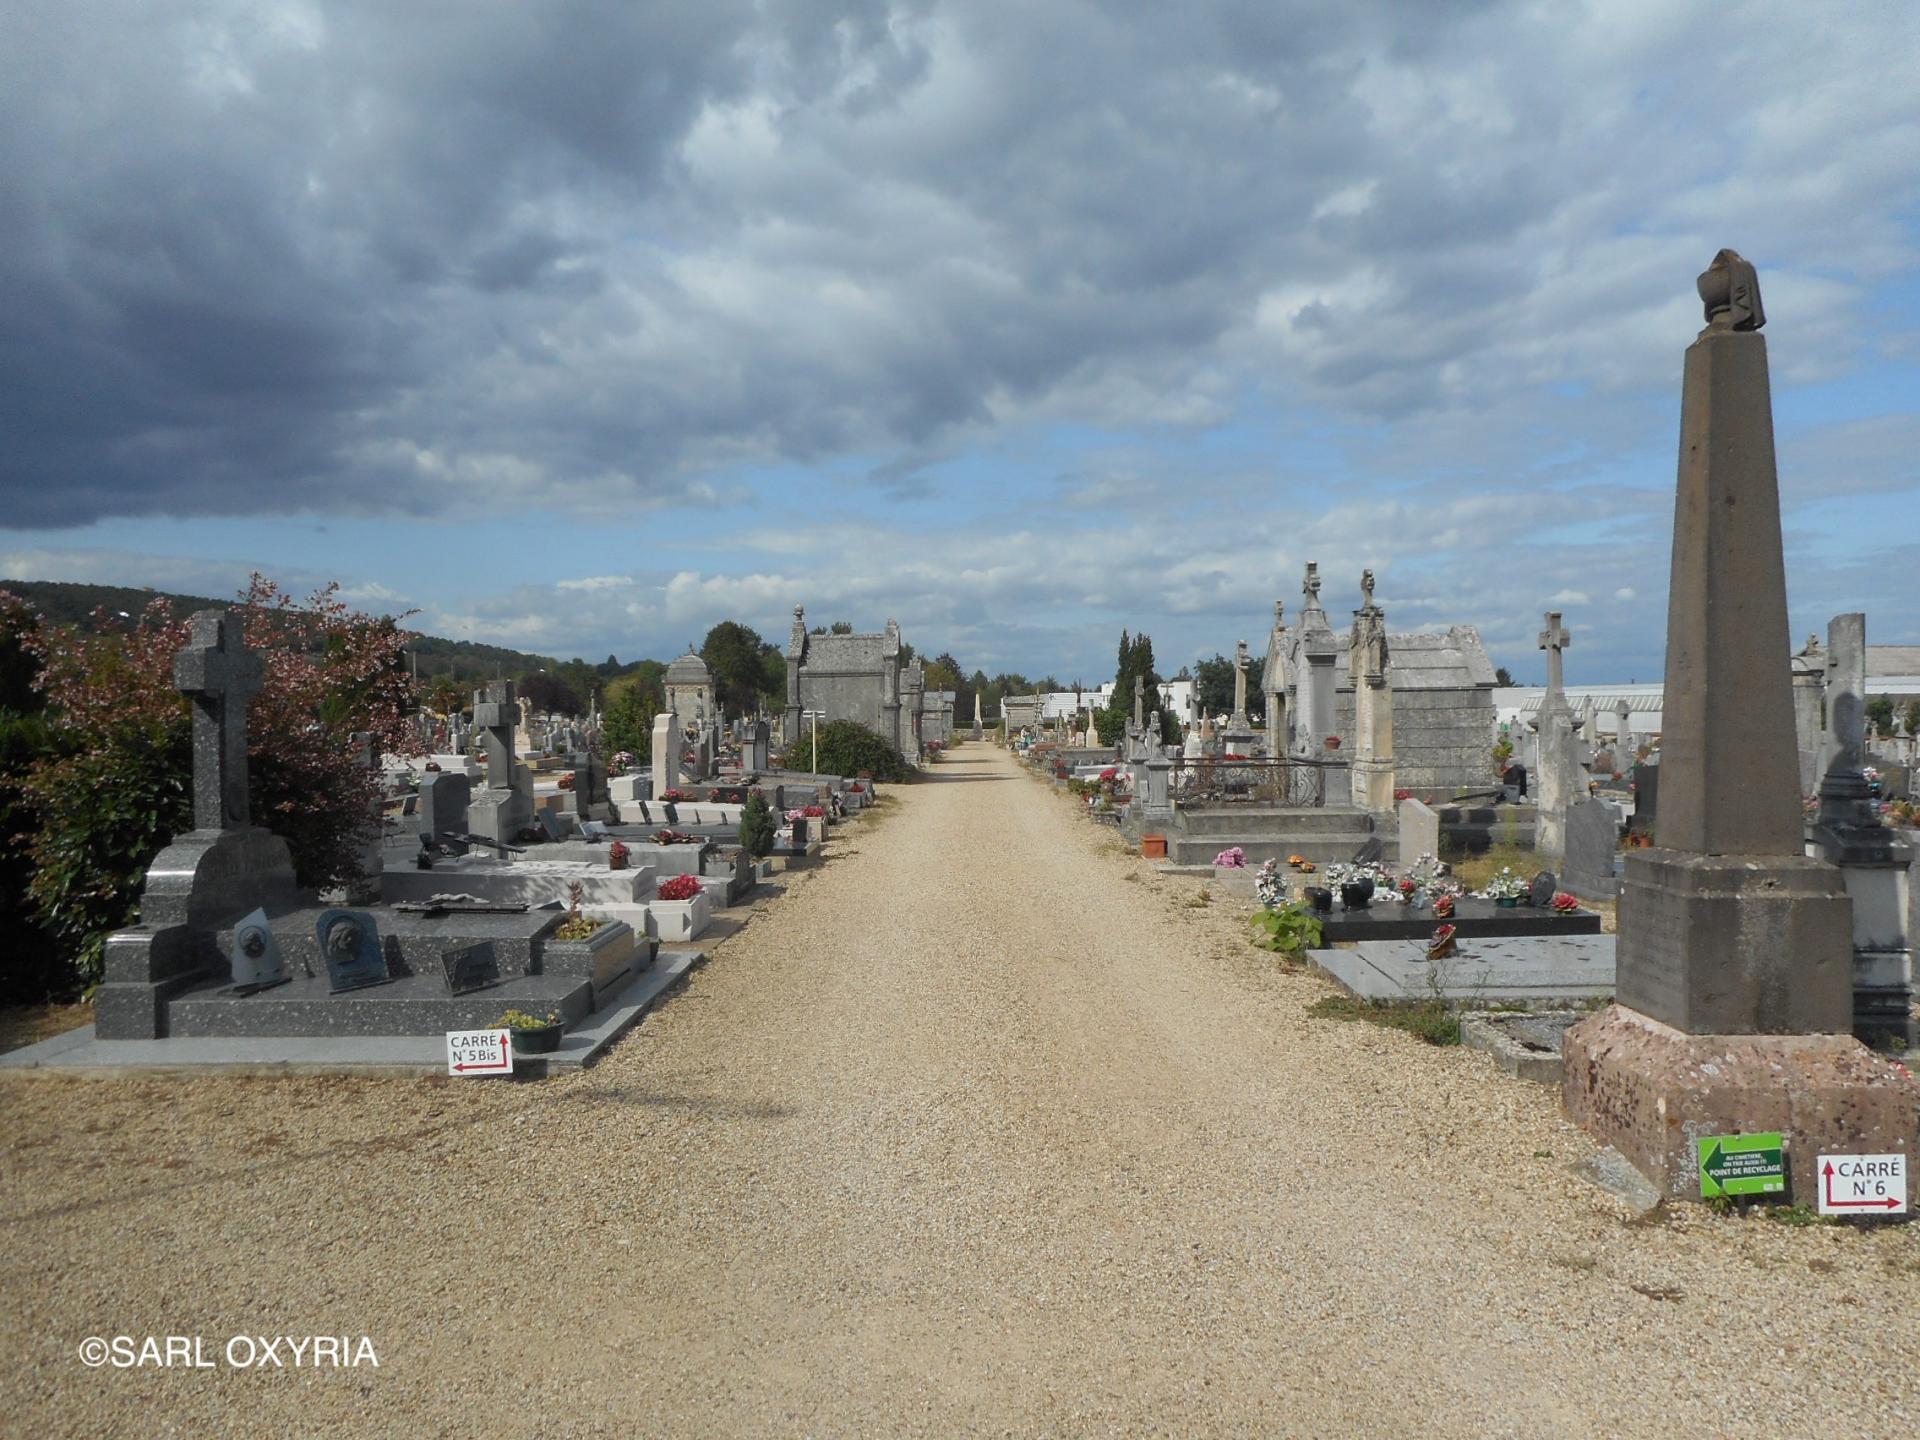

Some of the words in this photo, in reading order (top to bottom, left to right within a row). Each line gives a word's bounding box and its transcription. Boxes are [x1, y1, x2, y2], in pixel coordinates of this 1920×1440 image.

[451, 1032, 496, 1047] CARRÉ
[453, 1049, 466, 1062] N°
[1743, 1165, 1781, 1174] RECYCLAGE
[1838, 1157, 1900, 1177] CARRÉ
[1853, 1179, 1872, 1196] N°
[1875, 1180, 1886, 1195] 6
